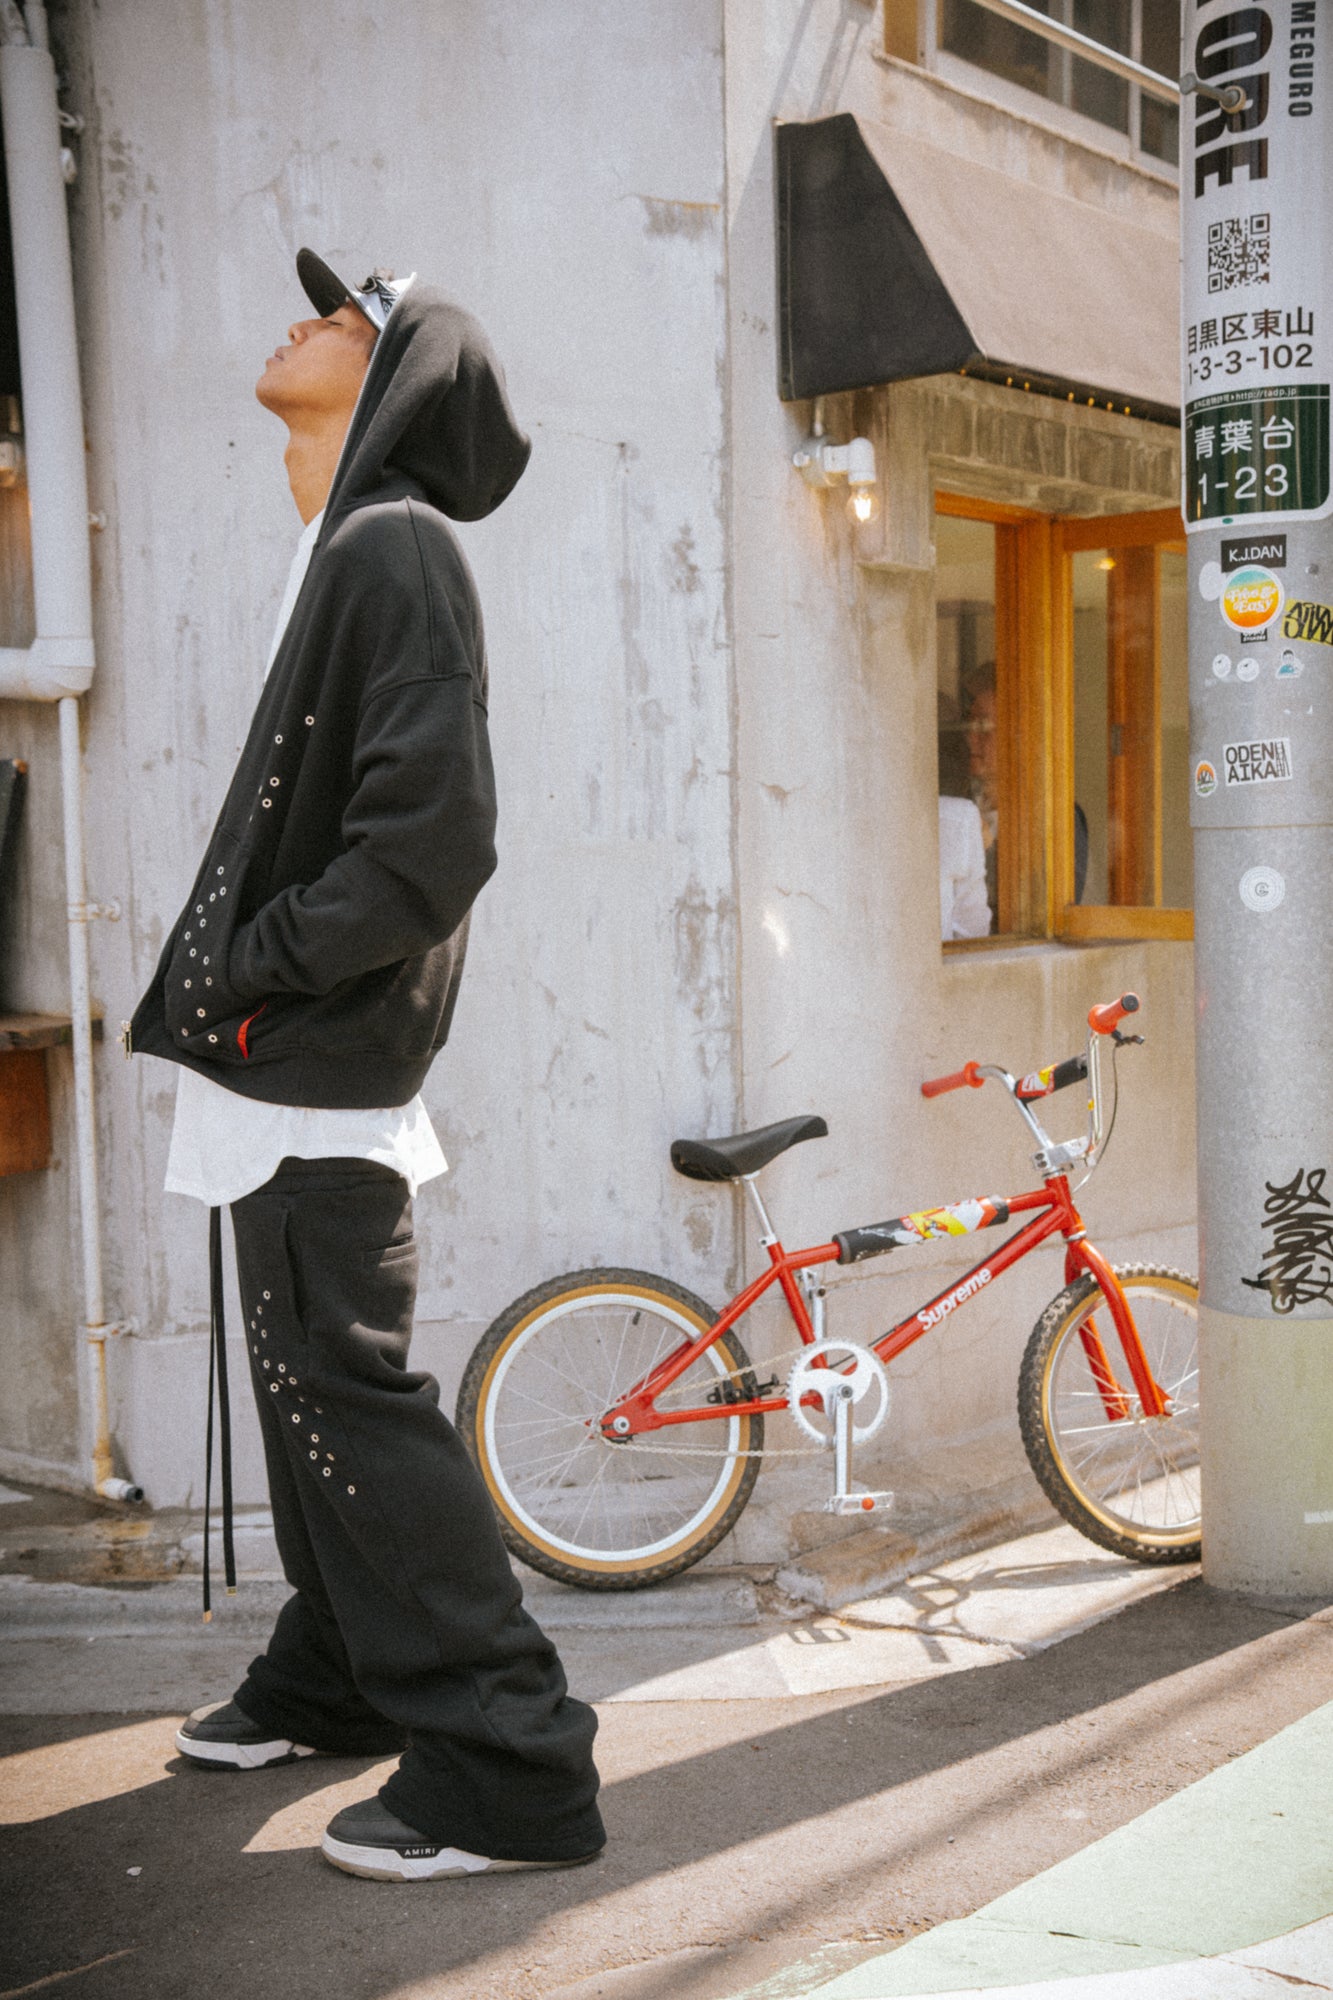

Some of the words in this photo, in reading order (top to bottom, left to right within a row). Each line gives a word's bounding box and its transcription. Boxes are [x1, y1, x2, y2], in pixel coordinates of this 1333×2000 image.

[1288, 1, 1316, 117] MEGURO
[1195, 0, 1273, 199] ORE
[1188, 306, 1314, 356] 目黒区東山
[1194, 415, 1295, 461] 青葉台
[1198, 463, 1289, 505] 1-23
[1229, 545, 1283, 562] K.J.DAN
[1226, 741, 1275, 764] ODEN
[1228, 761, 1279, 783] AIKA
[916, 1267, 992, 1331] Supreme
[404, 1847, 436, 1856] AMIRI
